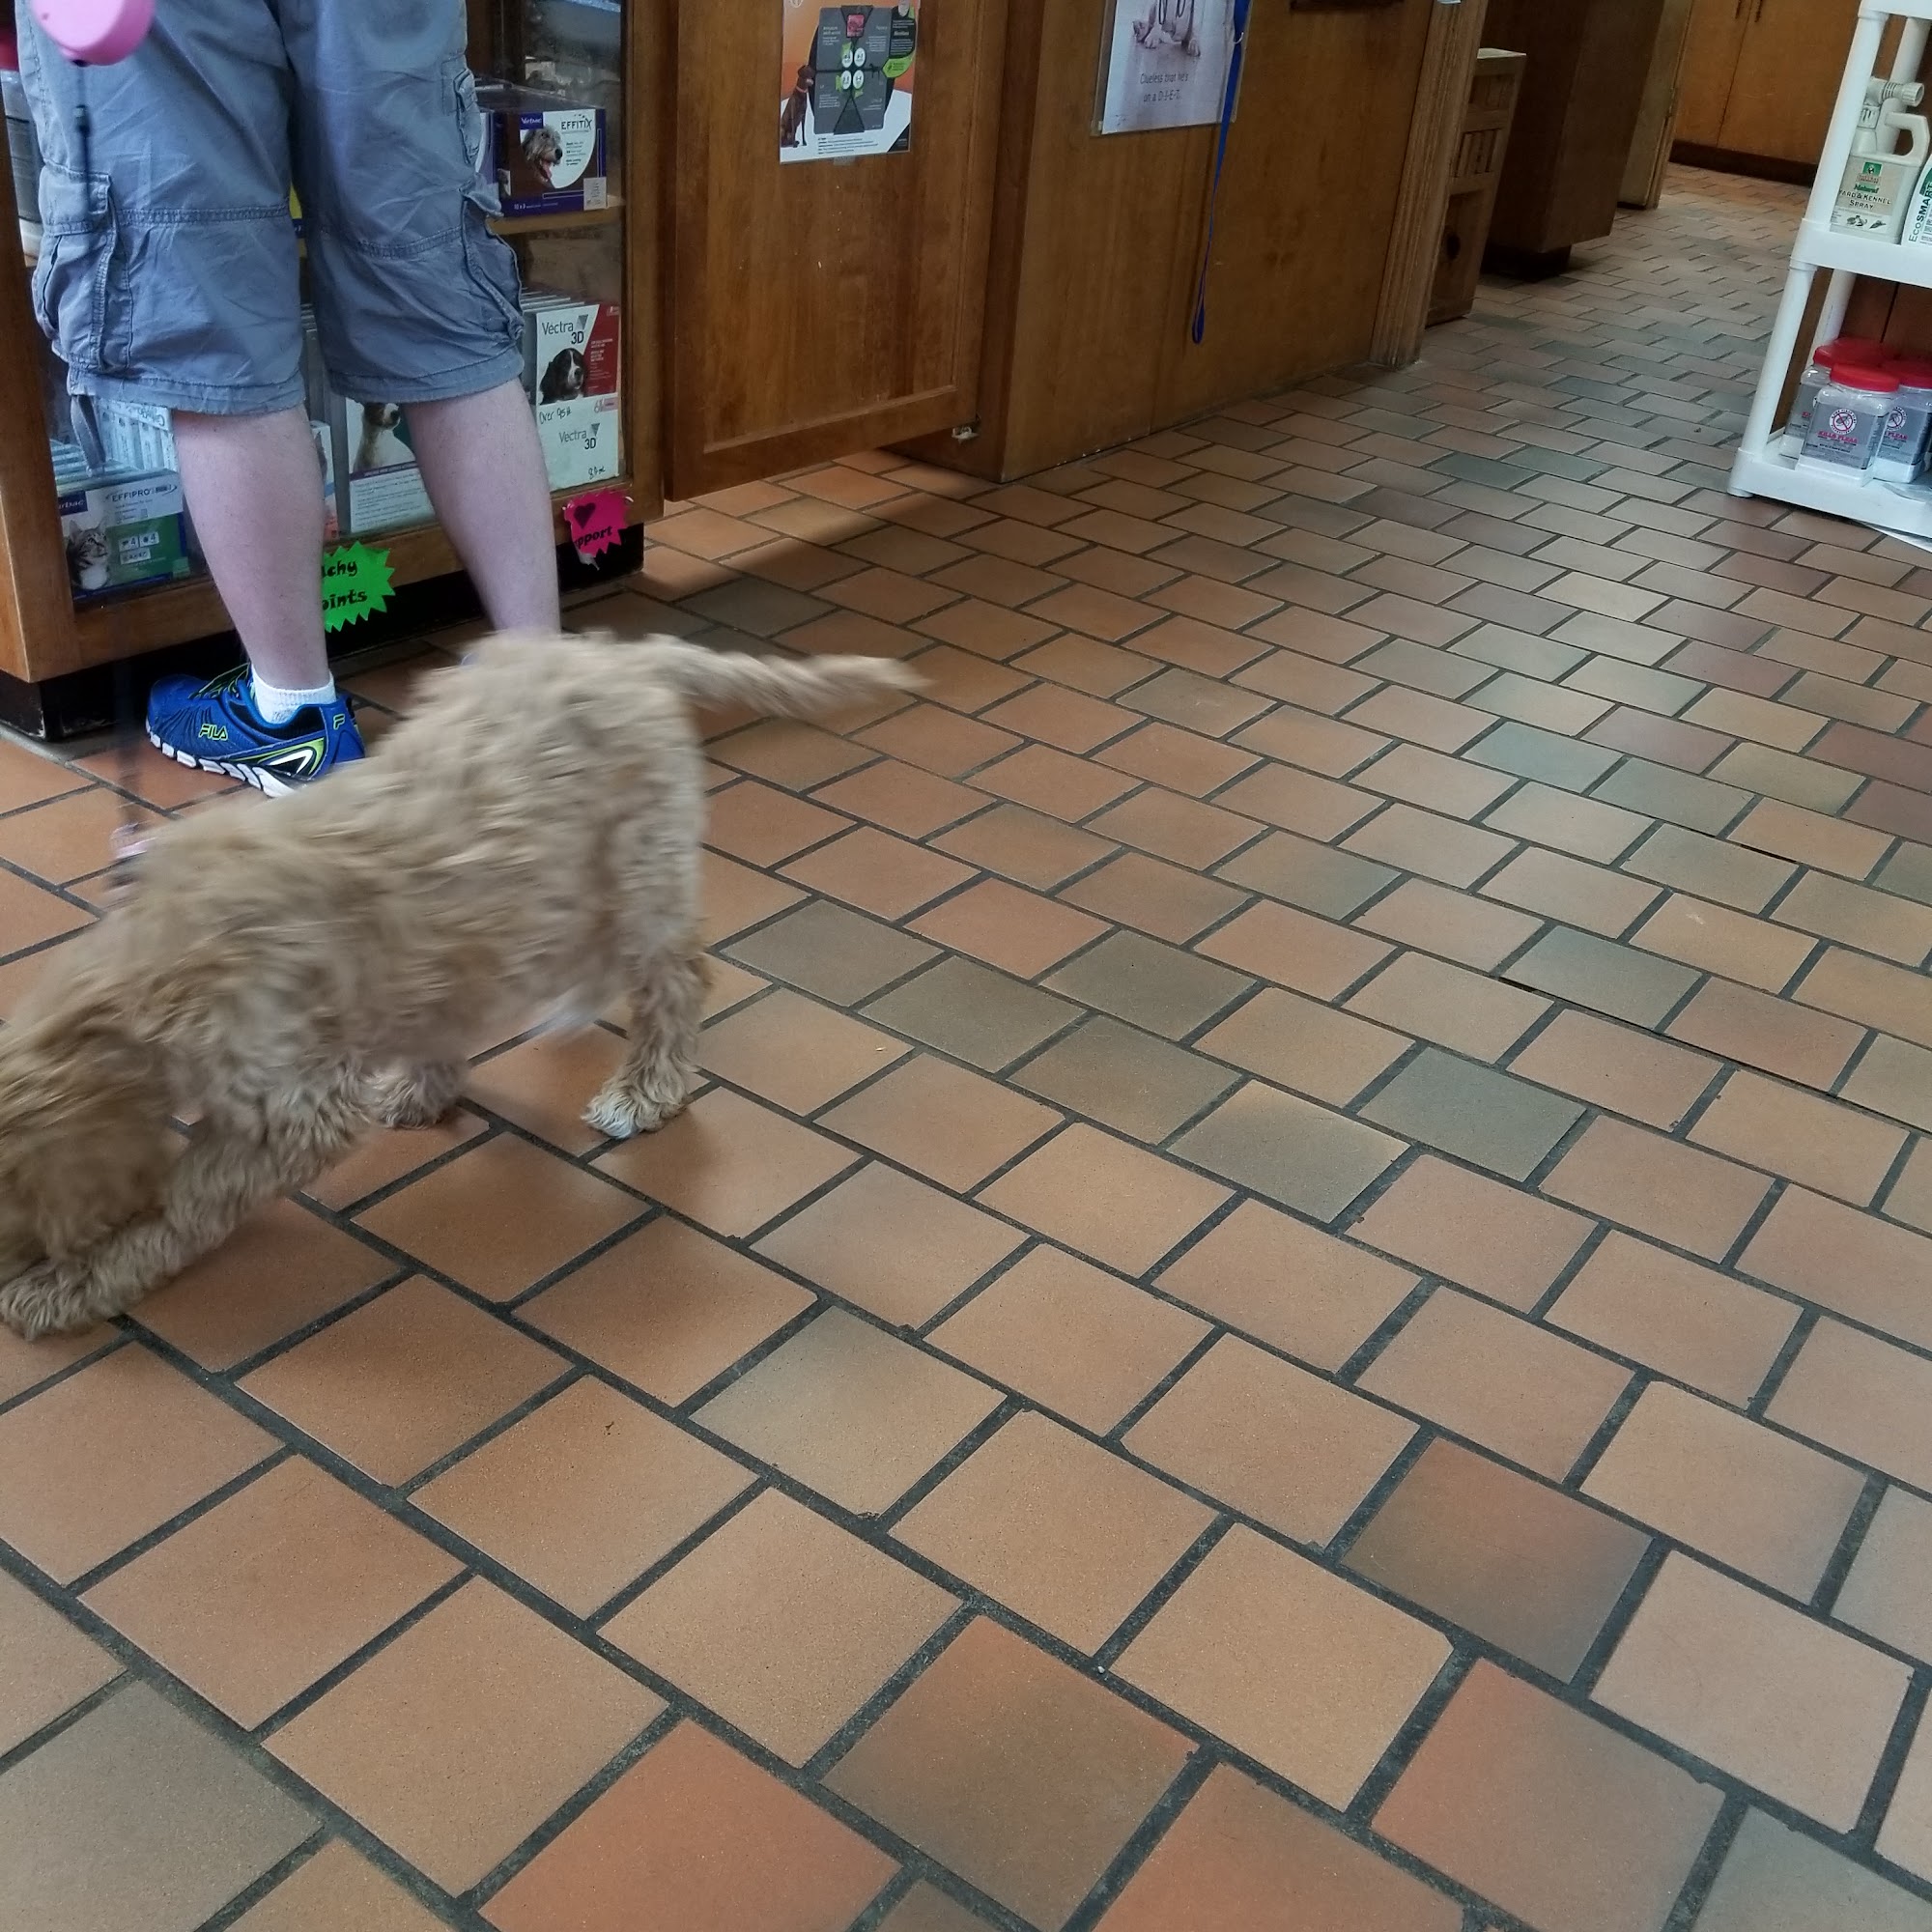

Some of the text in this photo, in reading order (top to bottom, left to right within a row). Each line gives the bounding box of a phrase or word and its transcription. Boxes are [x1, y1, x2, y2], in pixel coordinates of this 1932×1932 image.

[561, 117, 593, 130] EFFITIX
[1850, 199, 1874, 210] SPRAY
[1863, 193, 1891, 205] KENNEL
[542, 322, 574, 335] Vectra
[571, 331, 584, 345] 3D
[539, 411, 554, 425] Over
[558, 430, 587, 443] Vectra
[584, 437, 597, 450] 3D
[112, 488, 151, 502] EFFIPRO
[58, 498, 85, 510] irbac
[573, 526, 612, 549] pport
[322, 589, 368, 611] oints
[333, 713, 345, 730] F
[198, 723, 229, 741] FILA
